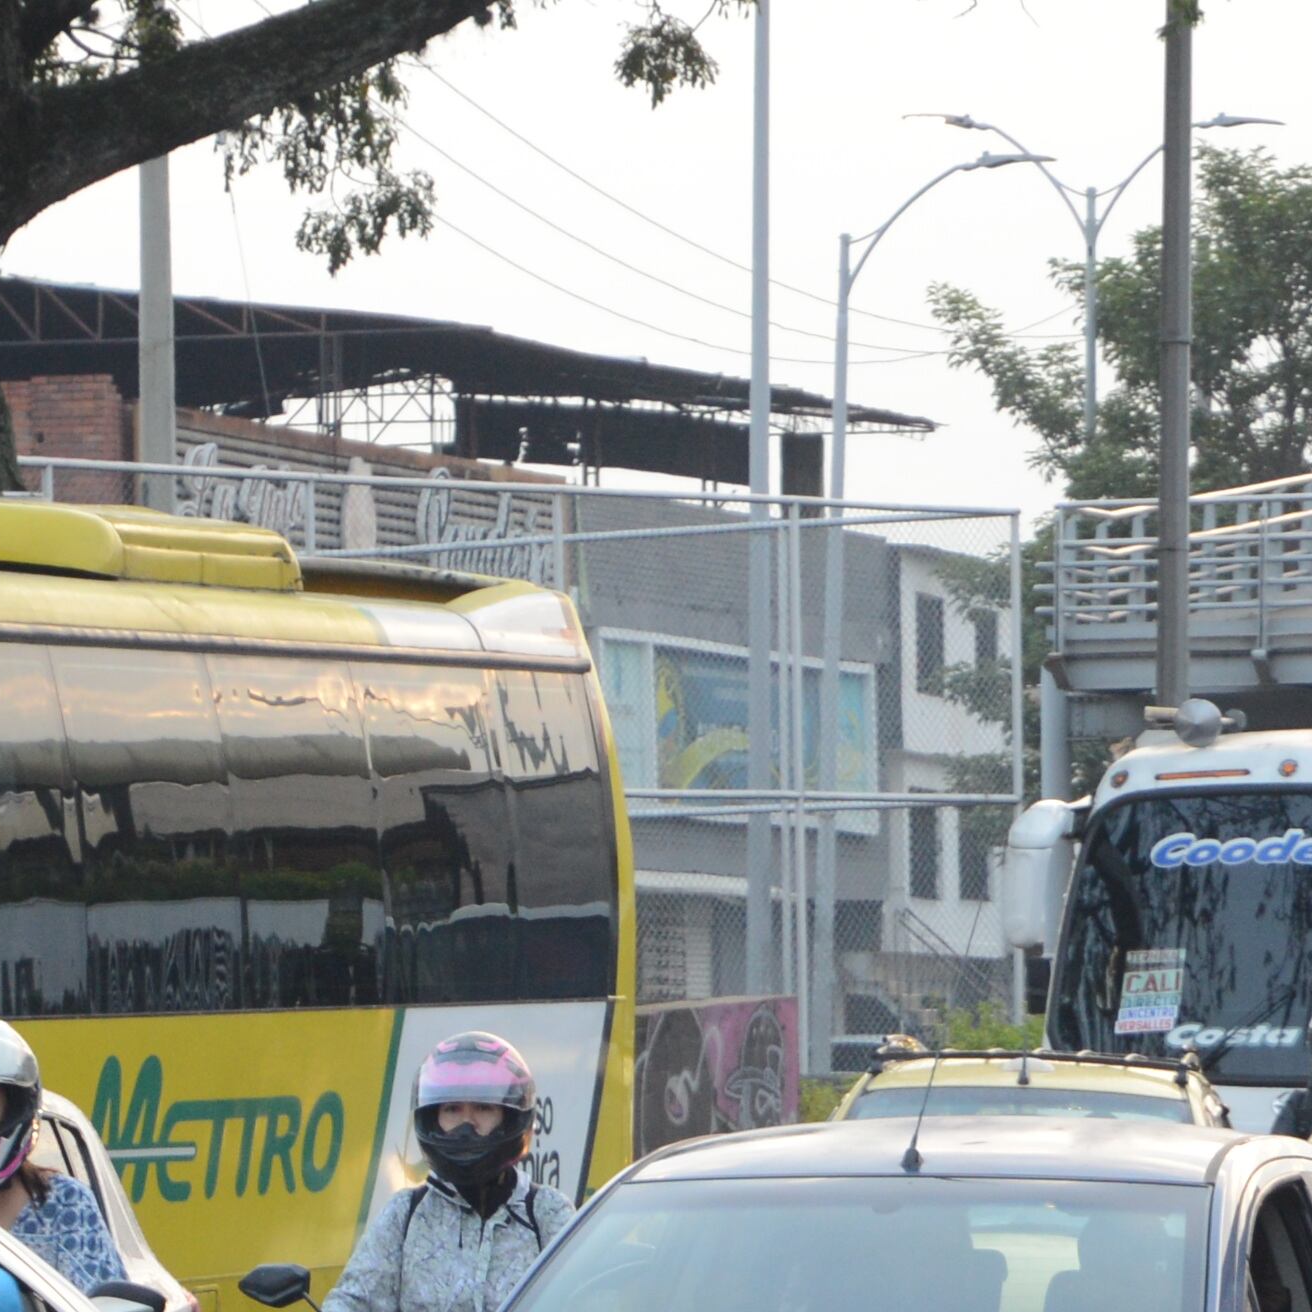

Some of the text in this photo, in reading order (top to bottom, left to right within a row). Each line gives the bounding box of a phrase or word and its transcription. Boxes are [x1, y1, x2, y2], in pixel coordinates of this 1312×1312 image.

[1126, 971, 1181, 993] CALI
[1166, 1021, 1304, 1049] Costa
[91, 1055, 344, 1204] METTRO
